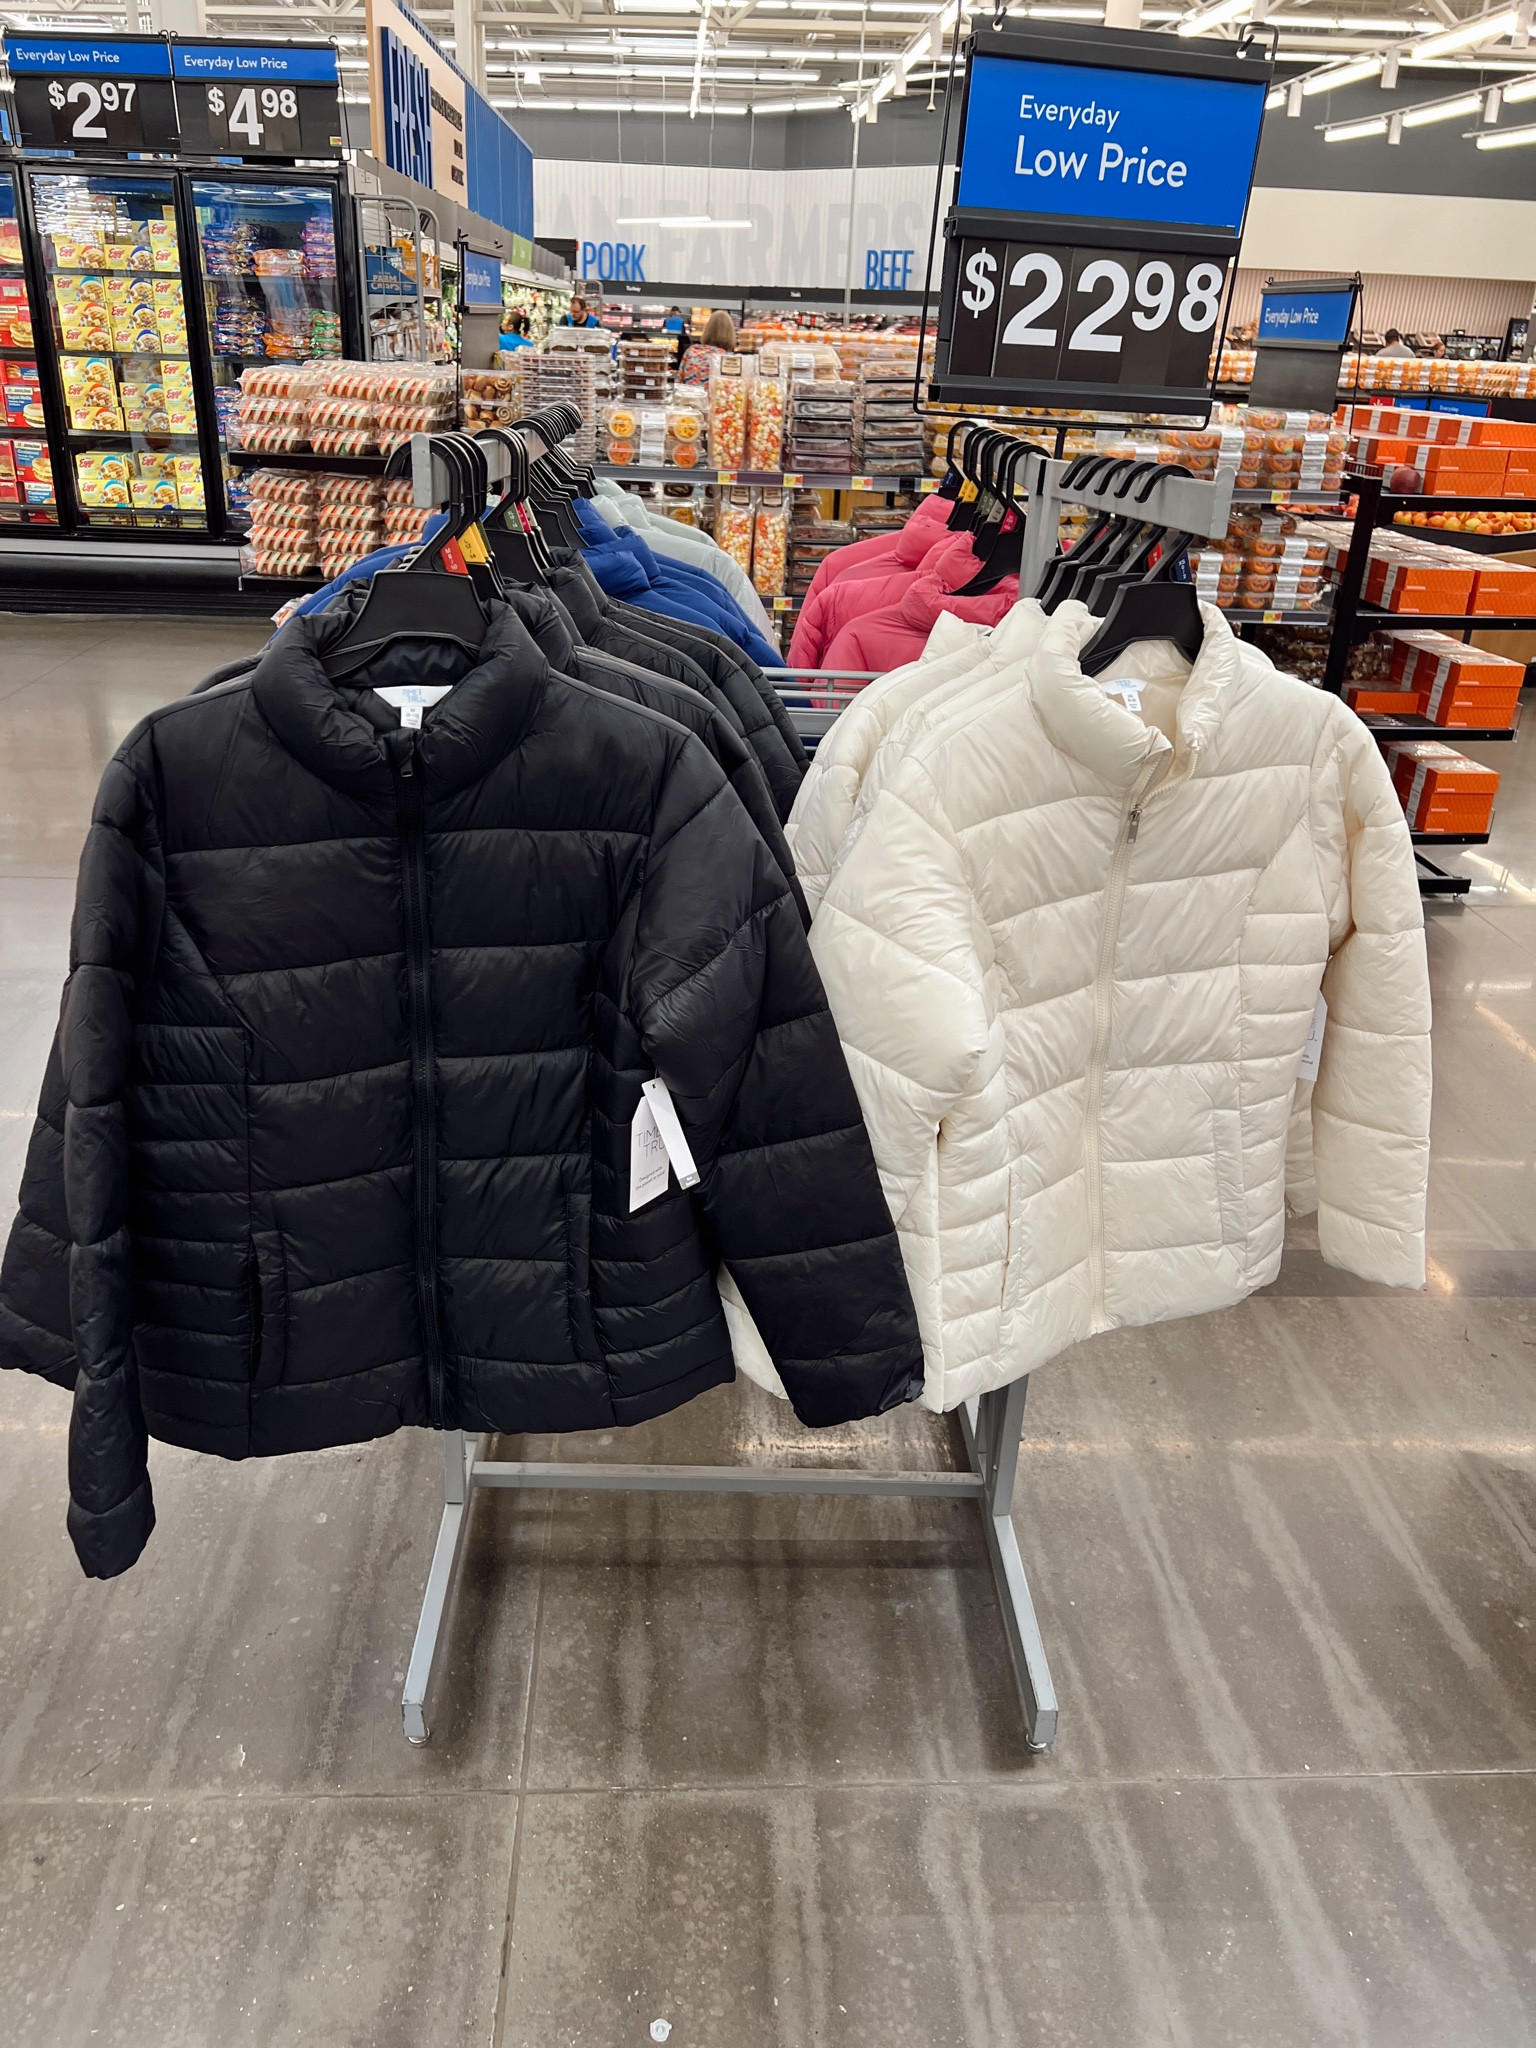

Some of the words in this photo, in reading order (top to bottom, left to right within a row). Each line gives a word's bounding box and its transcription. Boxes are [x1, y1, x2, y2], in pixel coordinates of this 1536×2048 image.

[16, 48, 65, 64] Everyday
[68, 50, 90, 62] Low
[93, 51, 120, 63] Price
[184, 55, 233, 70] Everyday
[236, 57, 257, 68] Low
[261, 57, 287, 69] Price
[380, 26, 434, 190] FRESH
[1019, 94, 1120, 133] Everyday
[1014, 135, 1088, 180] Low
[1098, 142, 1188, 188] Price
[582, 241, 646, 282] PORK
[865, 249, 914, 291] BEEF
[1265, 307, 1289, 328] Everyday
[1290, 307, 1302, 323] Low
[1302, 307, 1319, 324] Price
